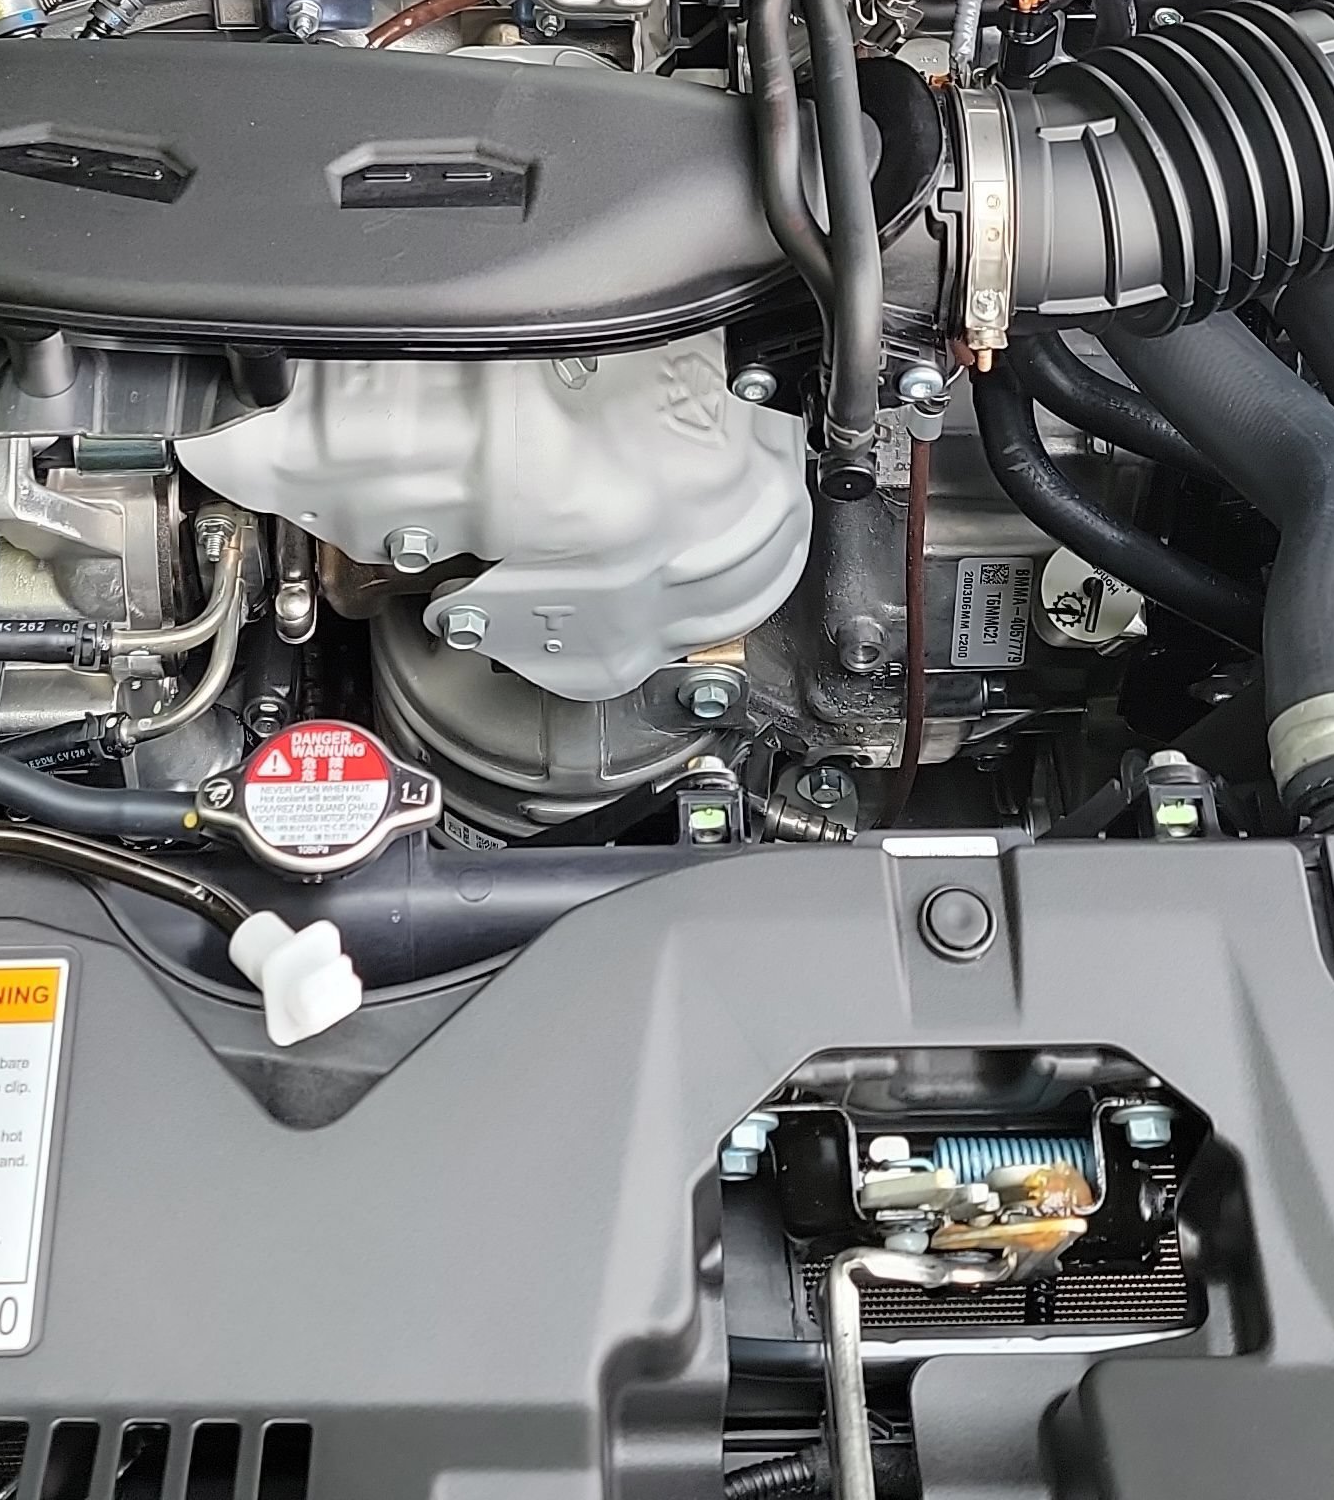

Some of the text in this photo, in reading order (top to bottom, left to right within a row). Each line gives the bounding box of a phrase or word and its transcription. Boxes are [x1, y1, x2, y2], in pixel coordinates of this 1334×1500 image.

[983, 592, 1002, 645] T6MMC21
[18, 621, 45, 633] 262
[290, 731, 352, 746] DANGER
[290, 742, 367, 759] WARNUNG
[0, 1057, 29, 1070] bare
[4, 1081, 31, 1097] clip.
[1, 1131, 22, 1143] hot
